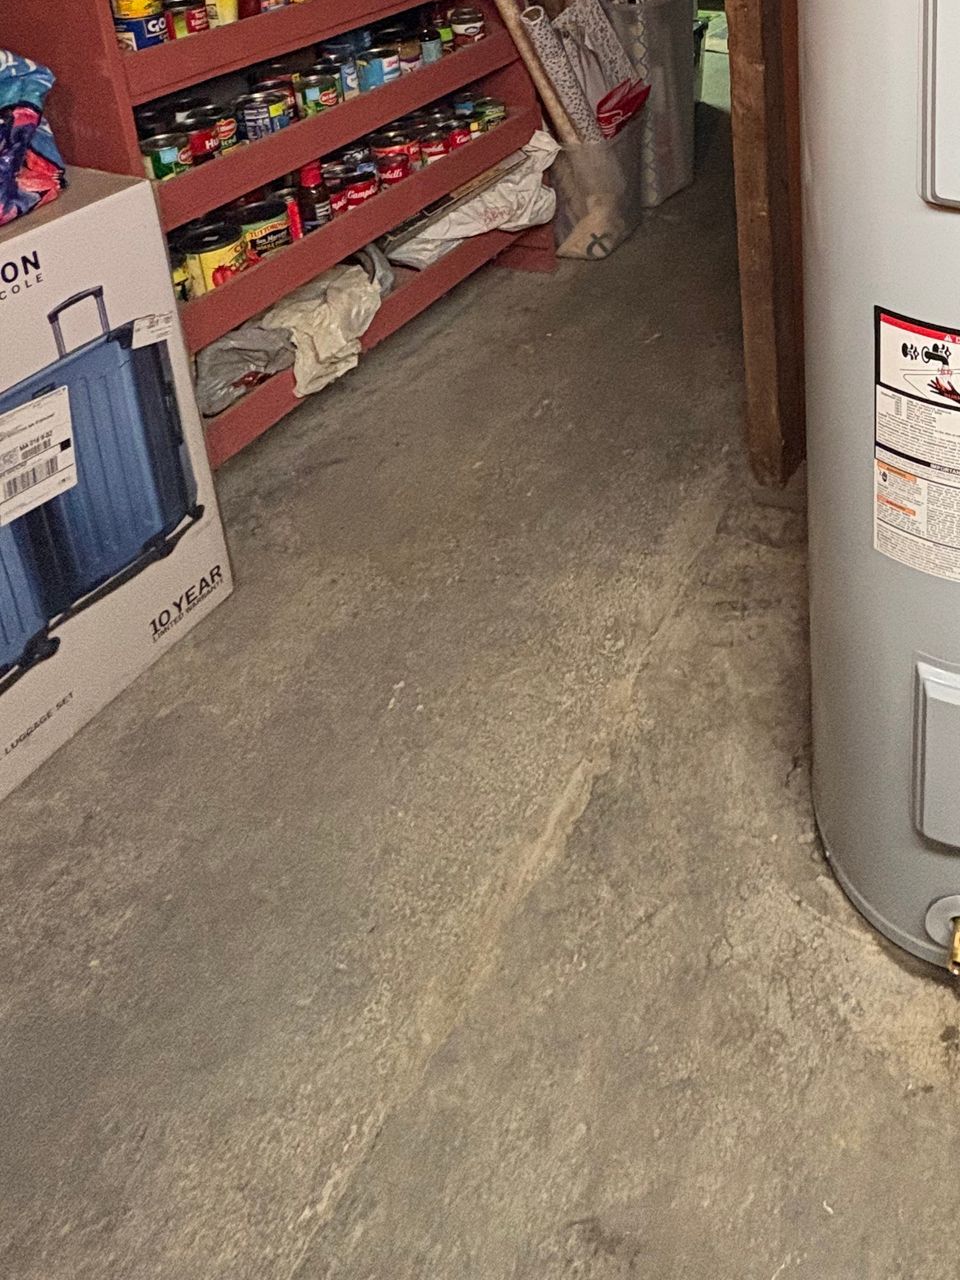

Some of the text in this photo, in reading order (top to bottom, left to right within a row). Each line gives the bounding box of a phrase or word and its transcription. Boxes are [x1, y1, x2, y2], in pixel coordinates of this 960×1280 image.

[1, 250, 41, 284] ON
[149, 564, 223, 637] 10 YEAR
